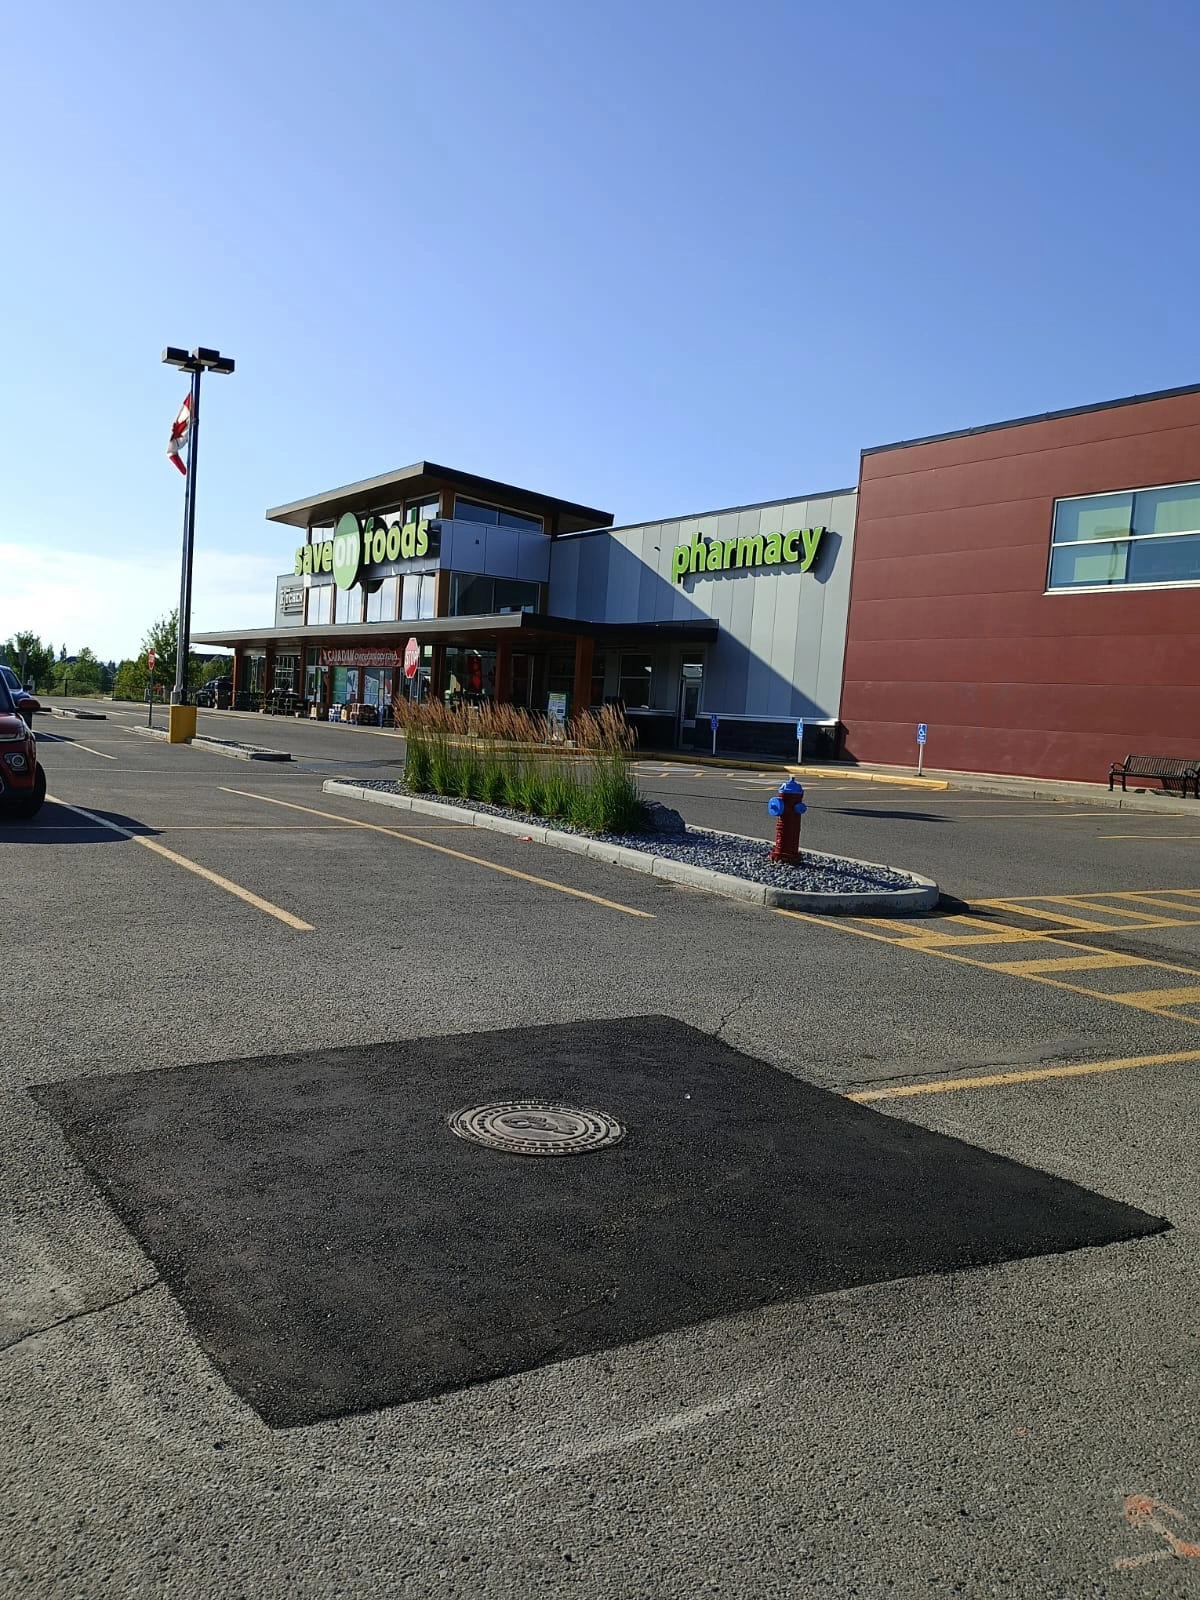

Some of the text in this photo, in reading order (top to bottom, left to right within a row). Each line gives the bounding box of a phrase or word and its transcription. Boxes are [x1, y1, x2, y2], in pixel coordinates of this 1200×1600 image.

[295, 507, 428, 577] save on foods
[672, 526, 824, 584] pharmacy
[405, 650, 418, 666] STOP
